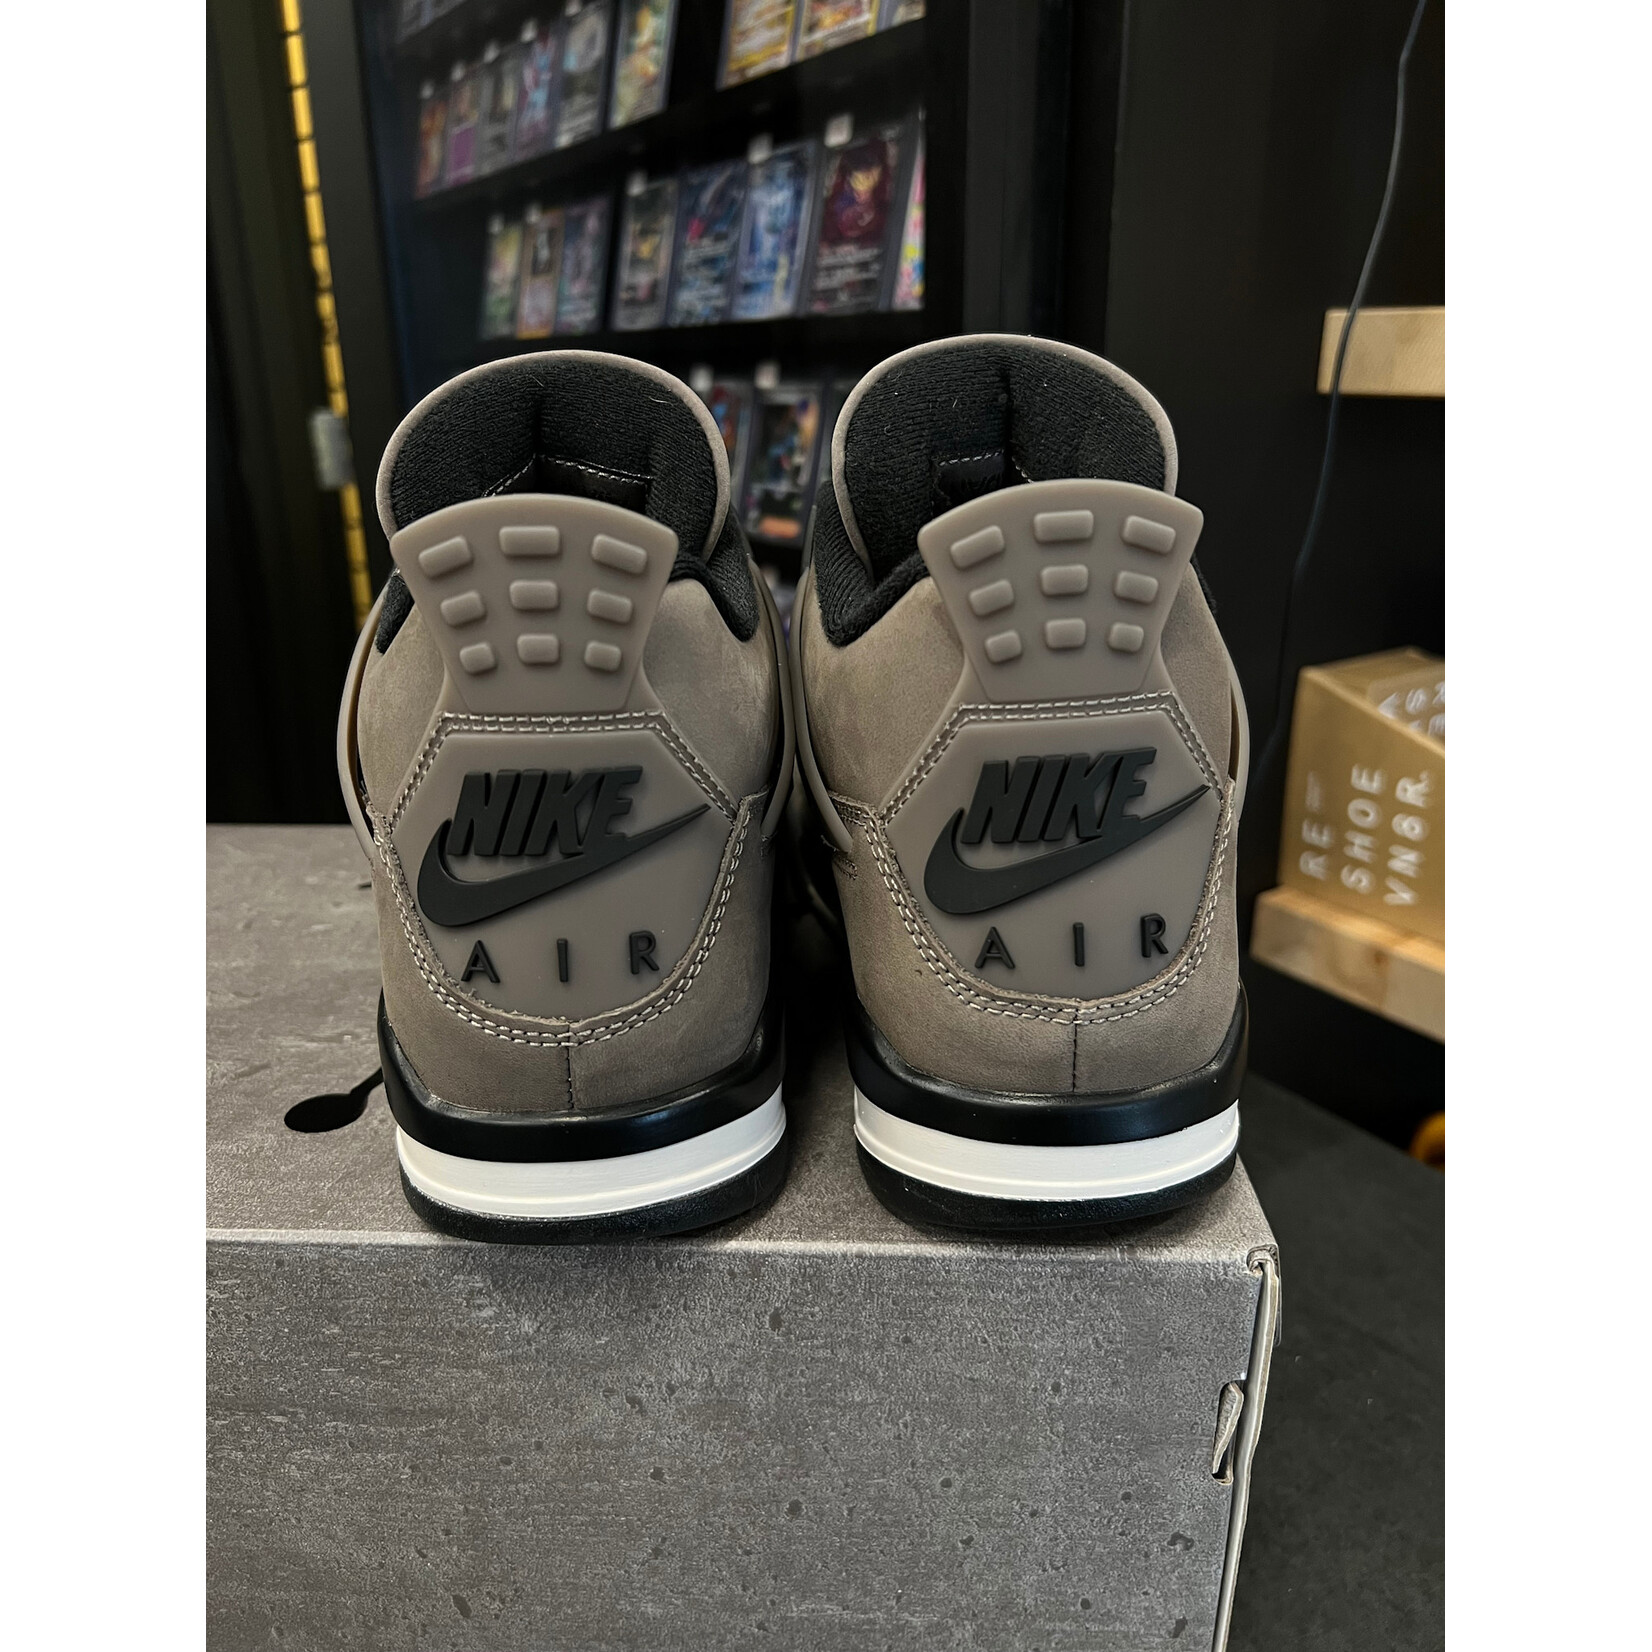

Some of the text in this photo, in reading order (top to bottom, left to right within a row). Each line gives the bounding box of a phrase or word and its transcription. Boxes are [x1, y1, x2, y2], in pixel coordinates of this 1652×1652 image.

[446, 765, 643, 856] NIKE
[961, 746, 1157, 844] NIKE
[1340, 763, 1386, 894] SHOE
[460, 930, 660, 983] AIR
[974, 913, 1169, 968] AIR
